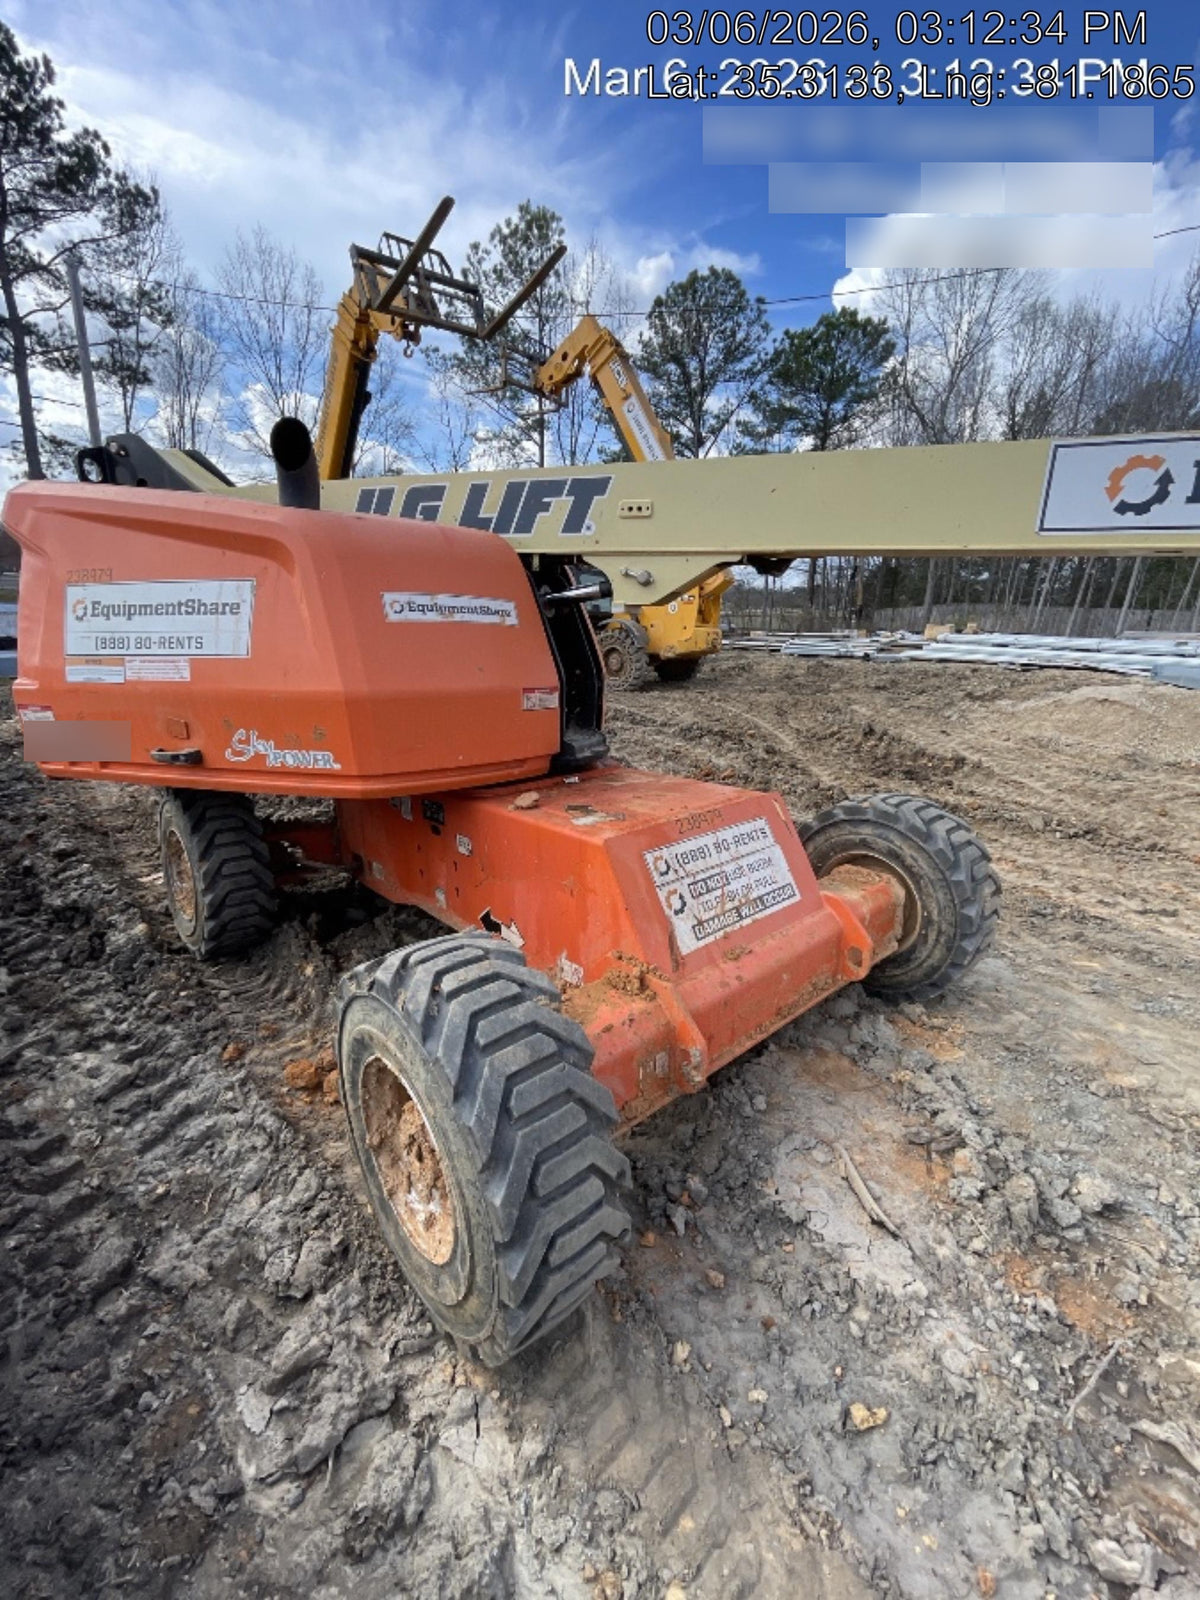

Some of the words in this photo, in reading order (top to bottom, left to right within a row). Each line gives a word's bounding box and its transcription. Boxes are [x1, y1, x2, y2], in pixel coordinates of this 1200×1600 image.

[457, 475, 614, 535] LIFT
[90, 598, 241, 621] EquipmentShare
[95, 636, 130, 650] (888)
[134, 636, 203, 650] 80-RENTS
[225, 728, 275, 762] Sky
[674, 844, 711, 870] (888)
[713, 827, 769, 854] 80-RENTS
